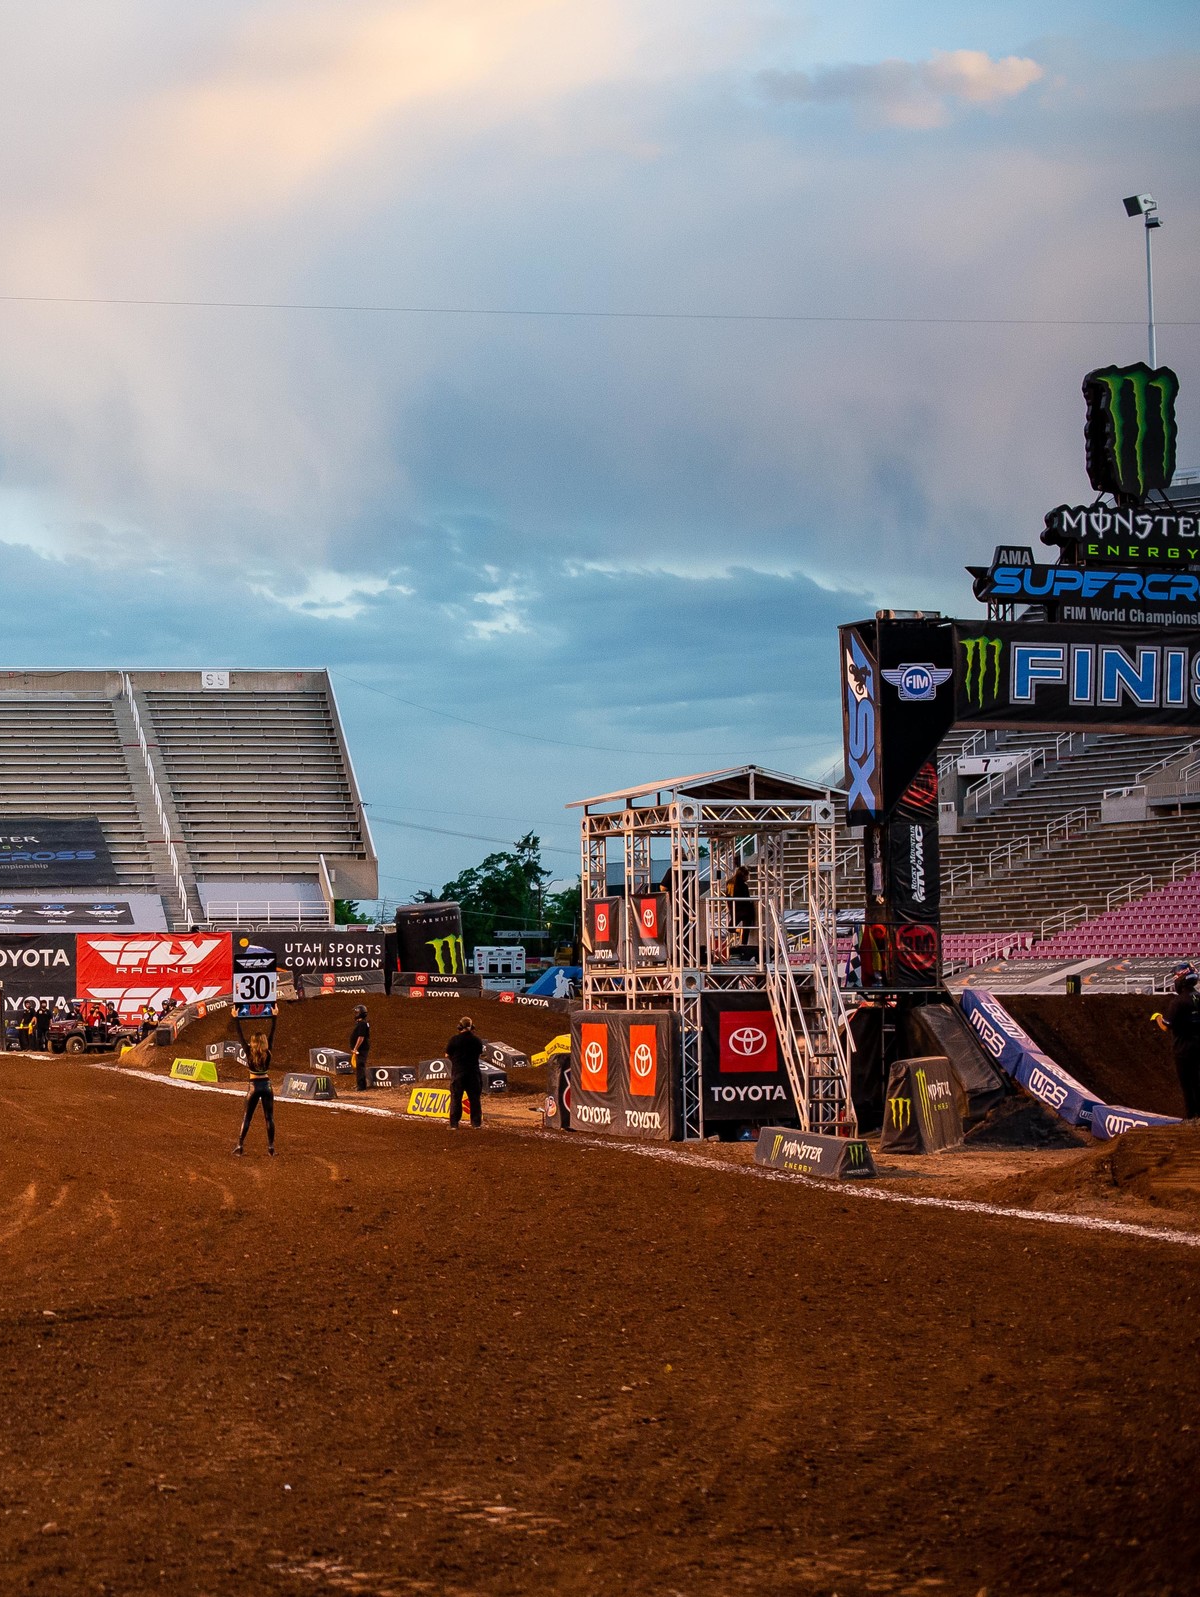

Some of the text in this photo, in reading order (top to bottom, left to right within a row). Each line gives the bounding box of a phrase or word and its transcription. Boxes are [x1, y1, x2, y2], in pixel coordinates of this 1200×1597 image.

[1061, 508, 1200, 539] MONSTE
[1000, 551, 1031, 565] AMA
[1087, 544, 1199, 559] ENERGY
[990, 567, 1200, 602] SUPERCR
[1063, 606, 1087, 620] FIM
[1090, 607, 1126, 622] World
[905, 674, 929, 690] FIM
[1009, 641, 1200, 709] FINI
[981, 758, 991, 772] 7
[86, 940, 223, 966] FLY
[284, 942, 382, 955] UTAH SPORTS
[638, 945, 660, 956] TOYOTA
[284, 956, 380, 968] COMMISSION
[240, 974, 270, 1000] 30
[336, 975, 364, 983] TOYOTA
[429, 975, 458, 984] TOYOTA
[206, 1000, 228, 1012] TOYOTA
[516, 996, 549, 1008] TOYOTA
[710, 1085, 787, 1102] TOYOTA
[1028, 1067, 1068, 1108] WPS
[576, 1104, 611, 1124] TOYOTA
[624, 1110, 661, 1129] TOYOTA
[782, 1140, 824, 1164] MONSTER
[784, 1161, 814, 1173] ENERGY
